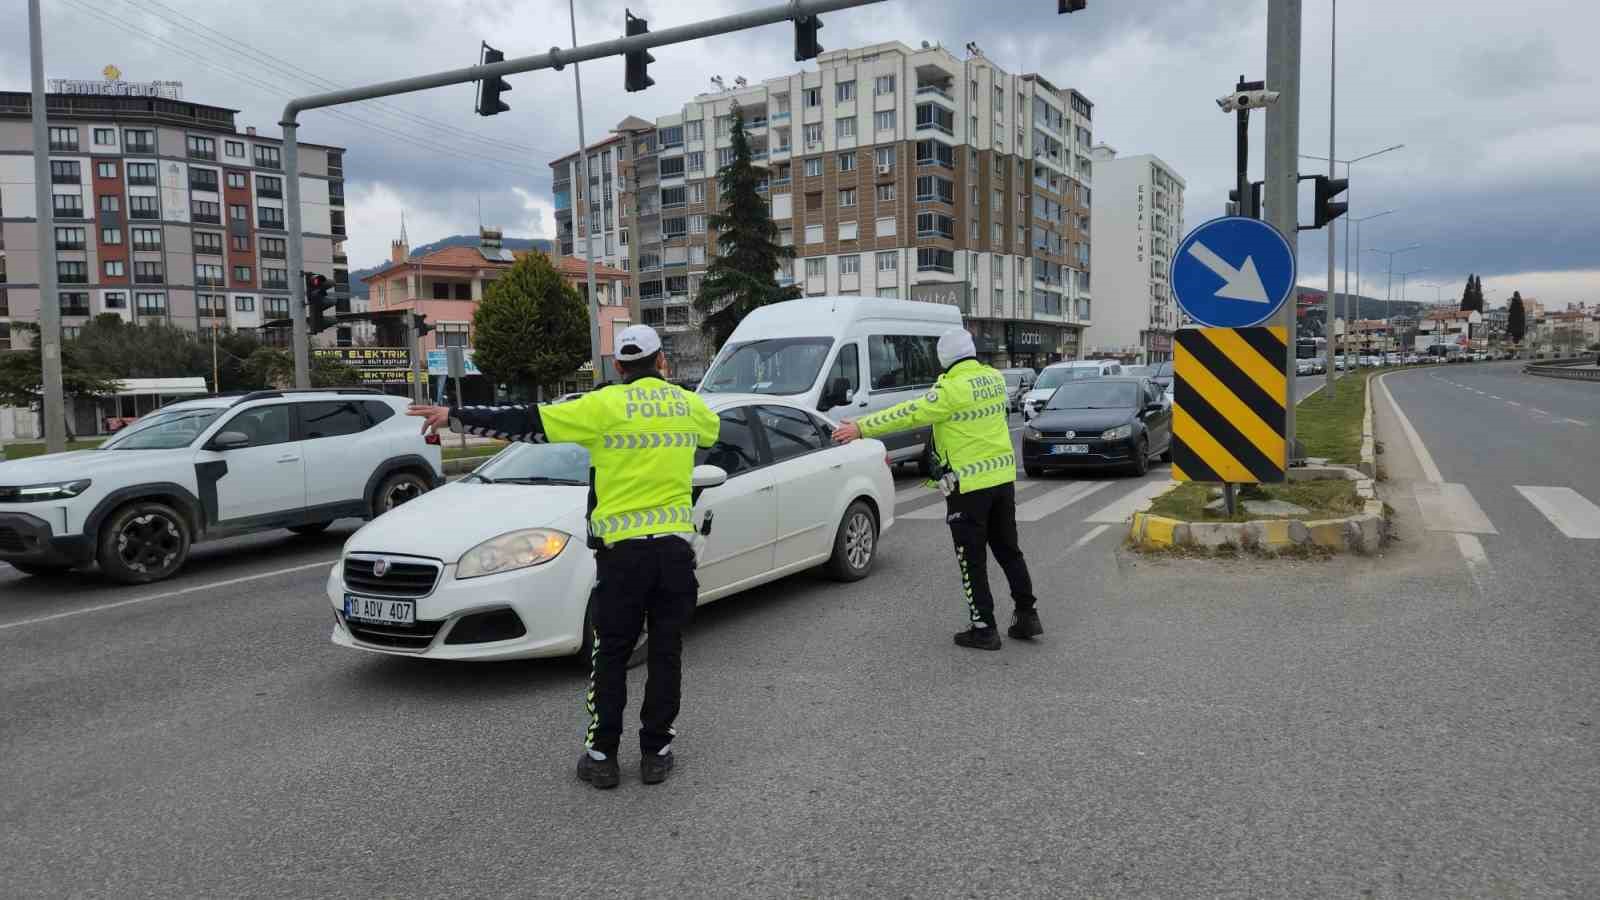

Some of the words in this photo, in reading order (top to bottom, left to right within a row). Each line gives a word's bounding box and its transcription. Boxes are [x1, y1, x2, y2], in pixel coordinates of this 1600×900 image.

[351, 598, 360, 615] 10
[365, 601, 383, 618] ADV
[391, 602, 411, 620] 407
